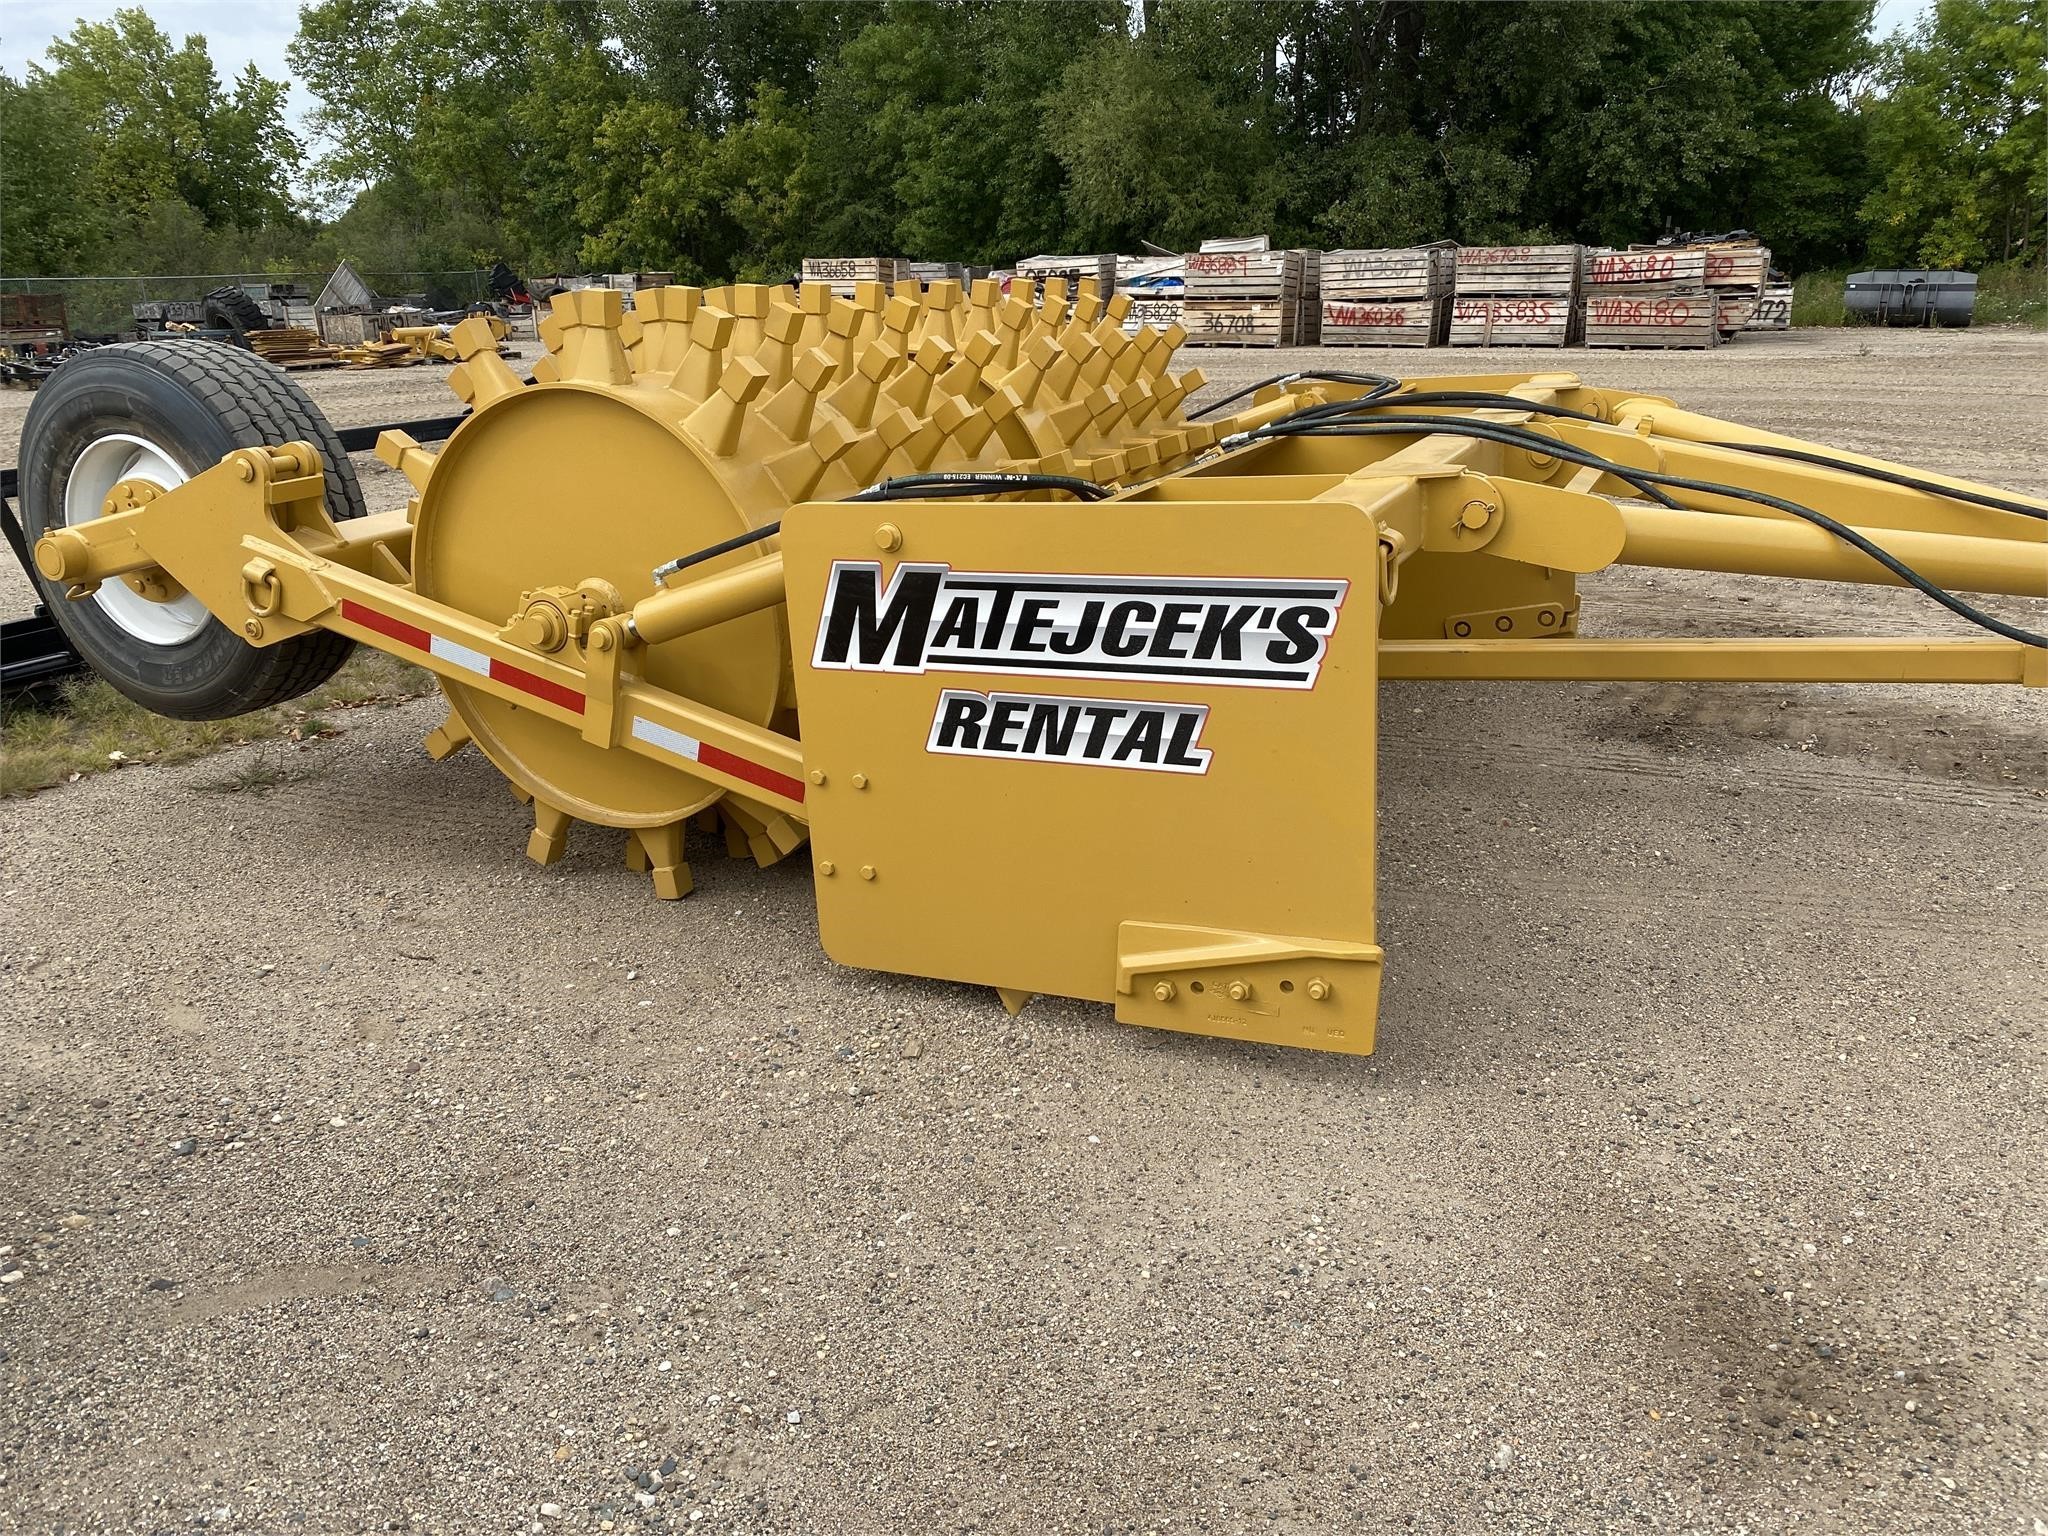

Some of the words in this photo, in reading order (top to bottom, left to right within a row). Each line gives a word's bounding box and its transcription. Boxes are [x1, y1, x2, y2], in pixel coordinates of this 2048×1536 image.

[1202, 312, 1255, 334] 36708
[821, 569, 1331, 668] MATEJCEK'S
[936, 697, 1204, 767] RENTAL
